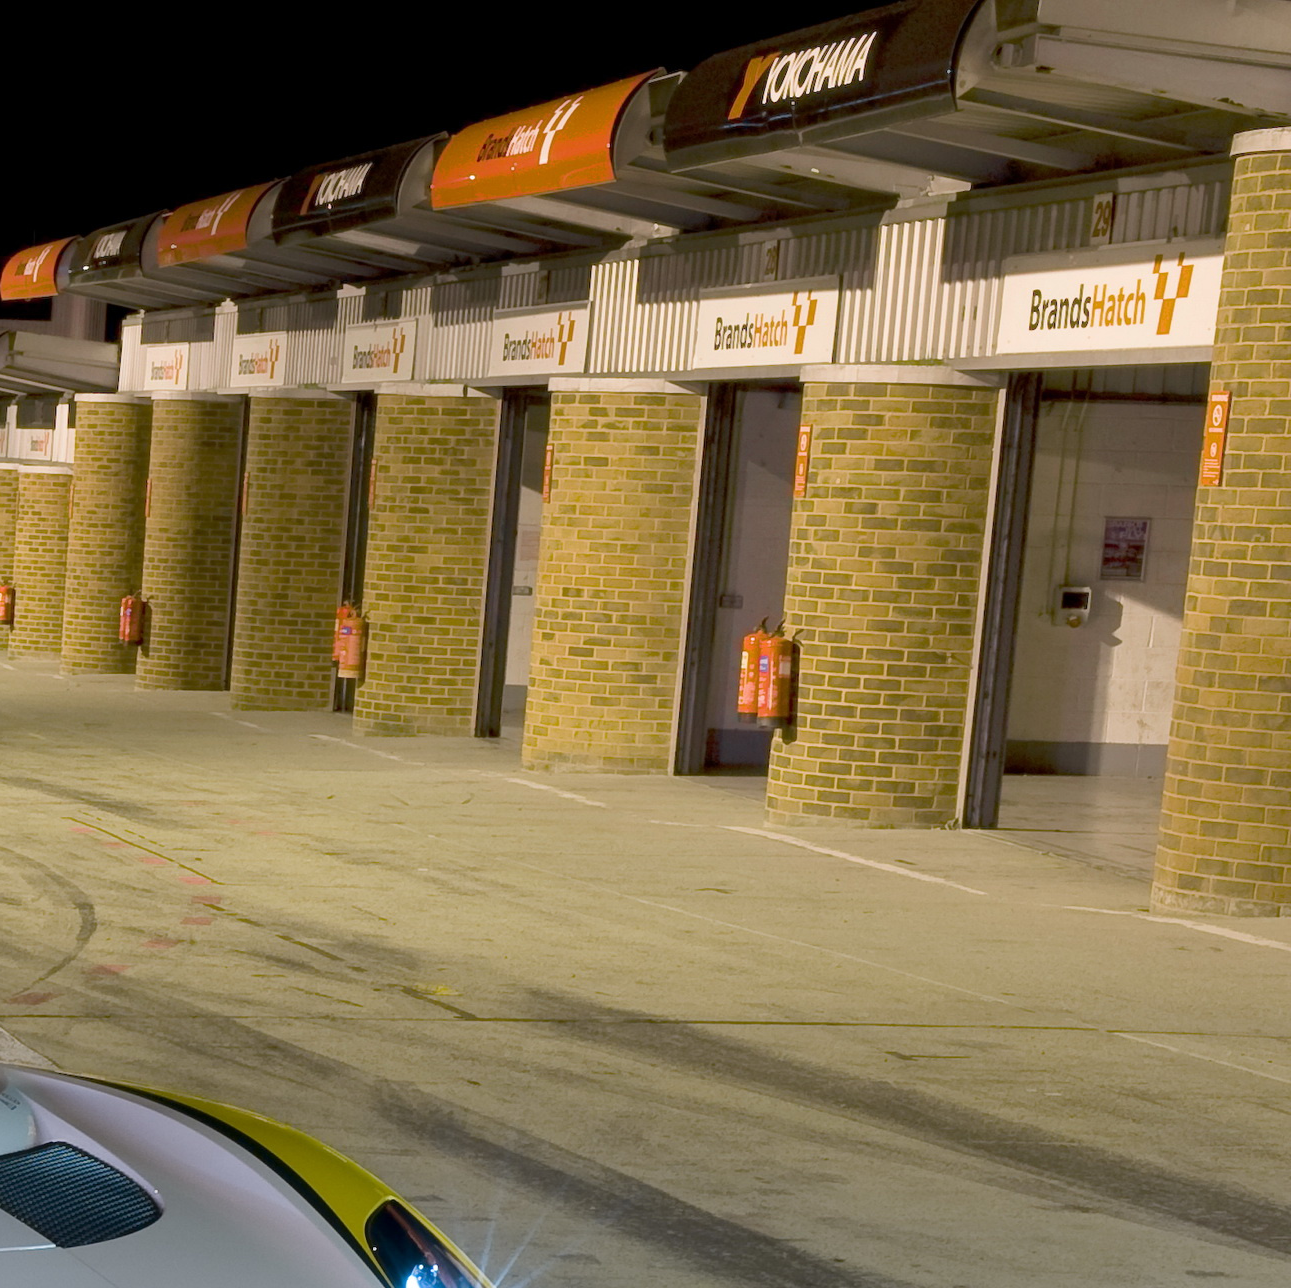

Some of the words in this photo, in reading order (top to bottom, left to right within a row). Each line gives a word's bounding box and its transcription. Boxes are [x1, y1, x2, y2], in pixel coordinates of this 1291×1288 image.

[762, 31, 877, 105] YOKOHAMA
[477, 119, 543, 162] BrandsHatch
[315, 162, 373, 206] YOKOHAMA
[1092, 200, 1112, 238] 29
[1029, 279, 1146, 330] BrandsHatch
[503, 328, 555, 361] BrandsHatch
[714, 309, 788, 350] BrandsHatch
[352, 341, 391, 370] BrandsHatch
